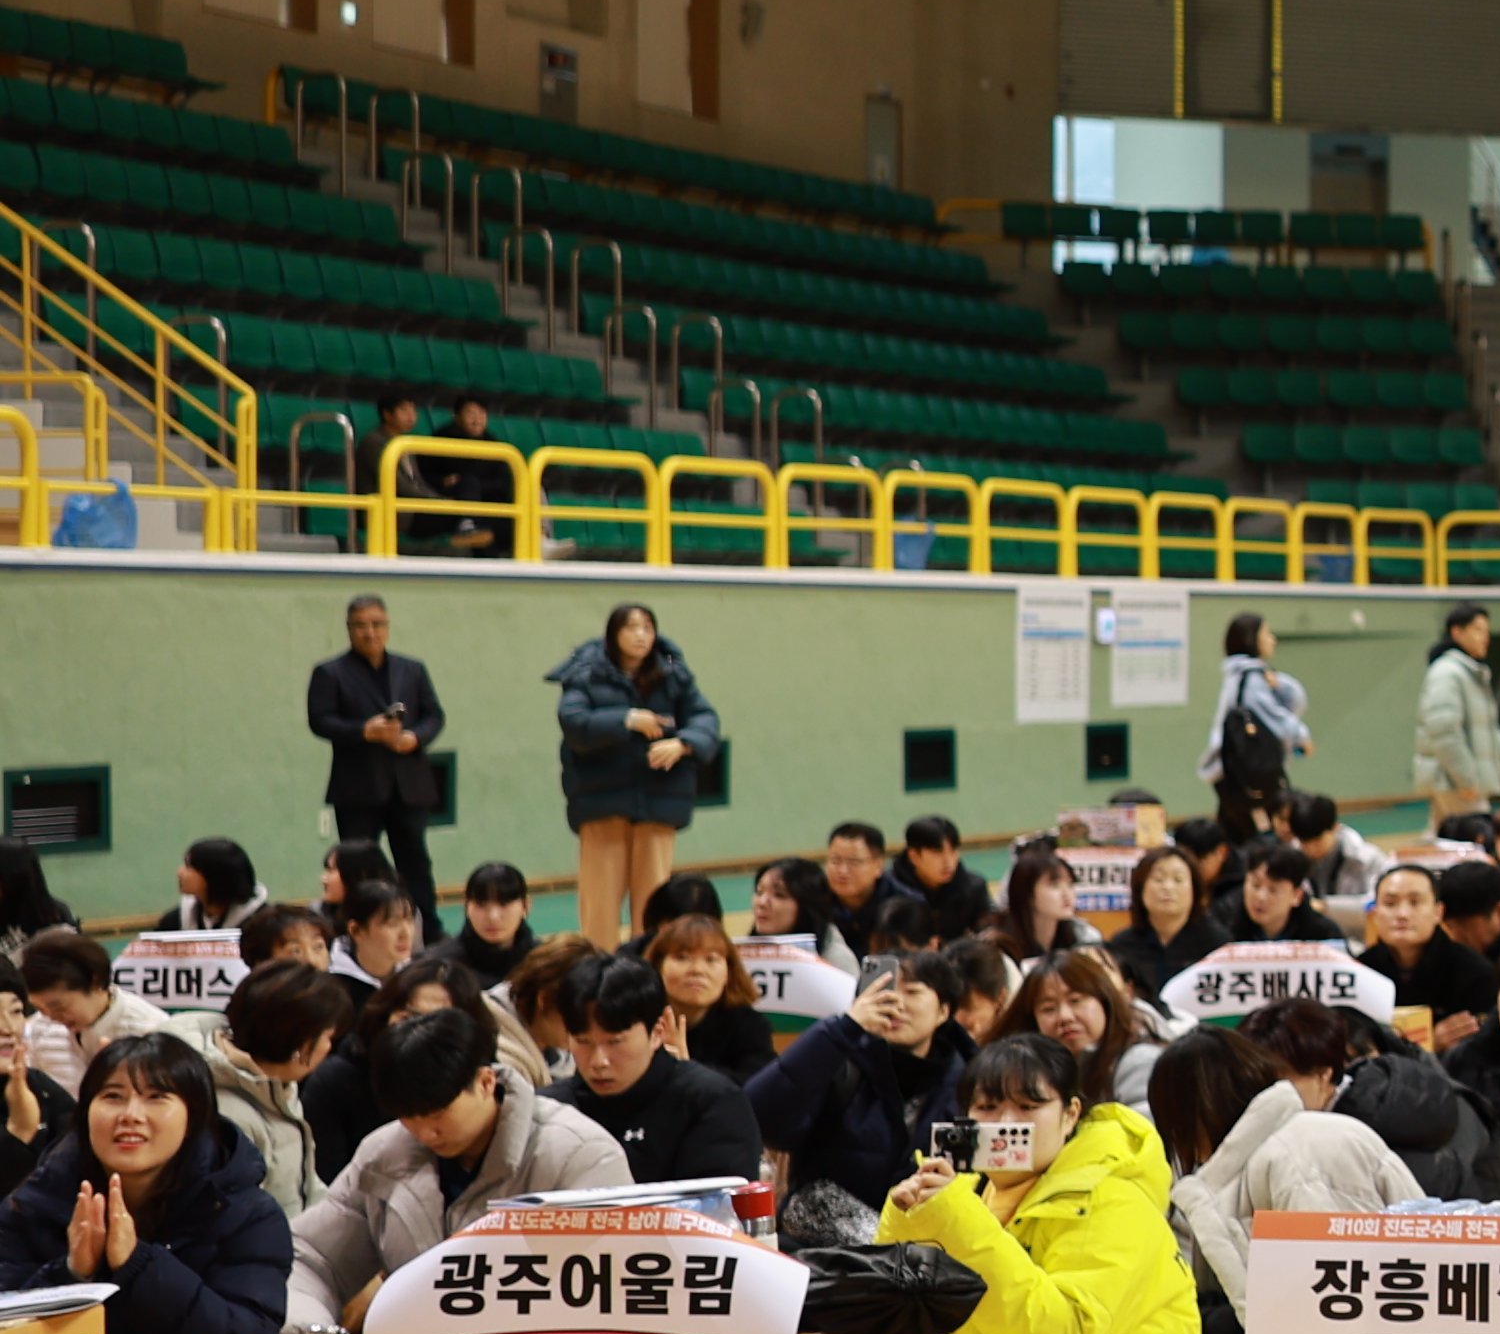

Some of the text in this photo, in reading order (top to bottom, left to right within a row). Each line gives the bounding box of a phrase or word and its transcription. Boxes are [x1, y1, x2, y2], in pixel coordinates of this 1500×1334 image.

[1195, 970, 1357, 1005] 광주배사모
[508, 1211, 588, 1230] 진도군수배
[591, 1212, 623, 1230] 전국
[1328, 1217, 1379, 1237] 제10회
[1384, 1217, 1462, 1238] 진도군수배
[1466, 1219, 1499, 1238] 전국
[433, 1252, 739, 1316] 광주어울림
